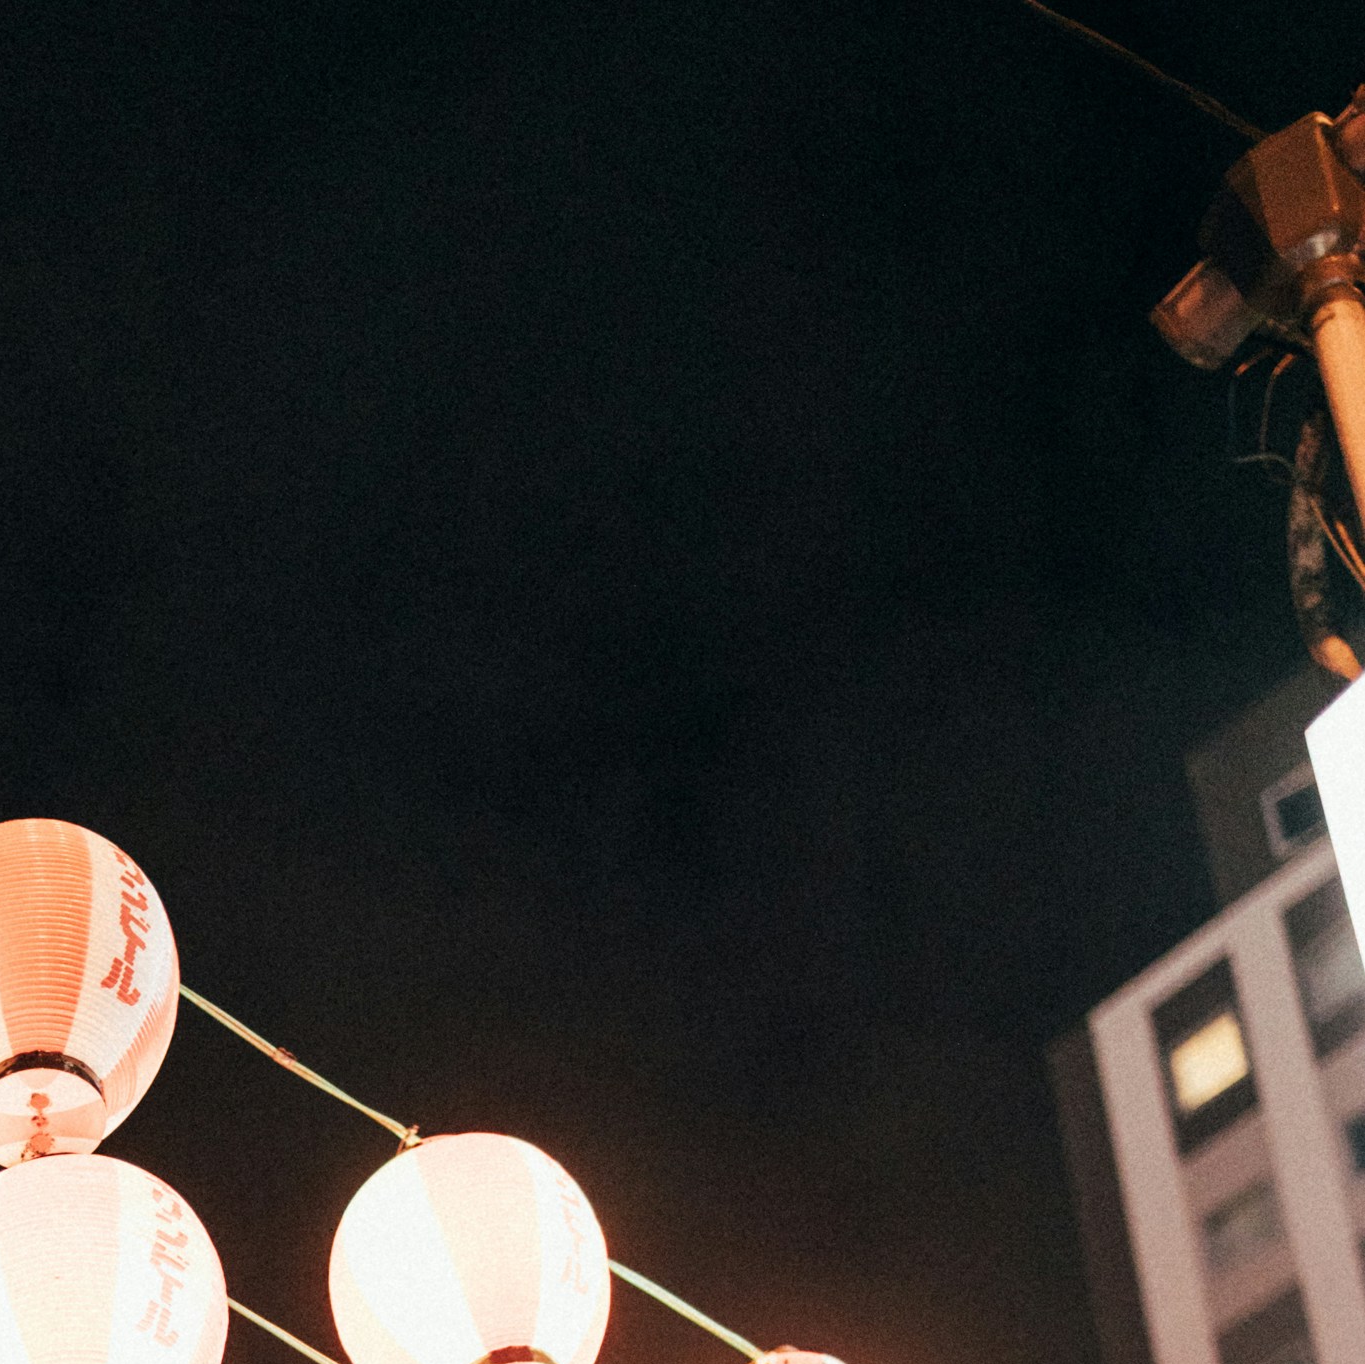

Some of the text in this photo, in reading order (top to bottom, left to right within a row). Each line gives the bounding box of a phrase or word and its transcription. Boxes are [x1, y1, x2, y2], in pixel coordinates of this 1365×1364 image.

[100, 845, 151, 1006] リンビール
